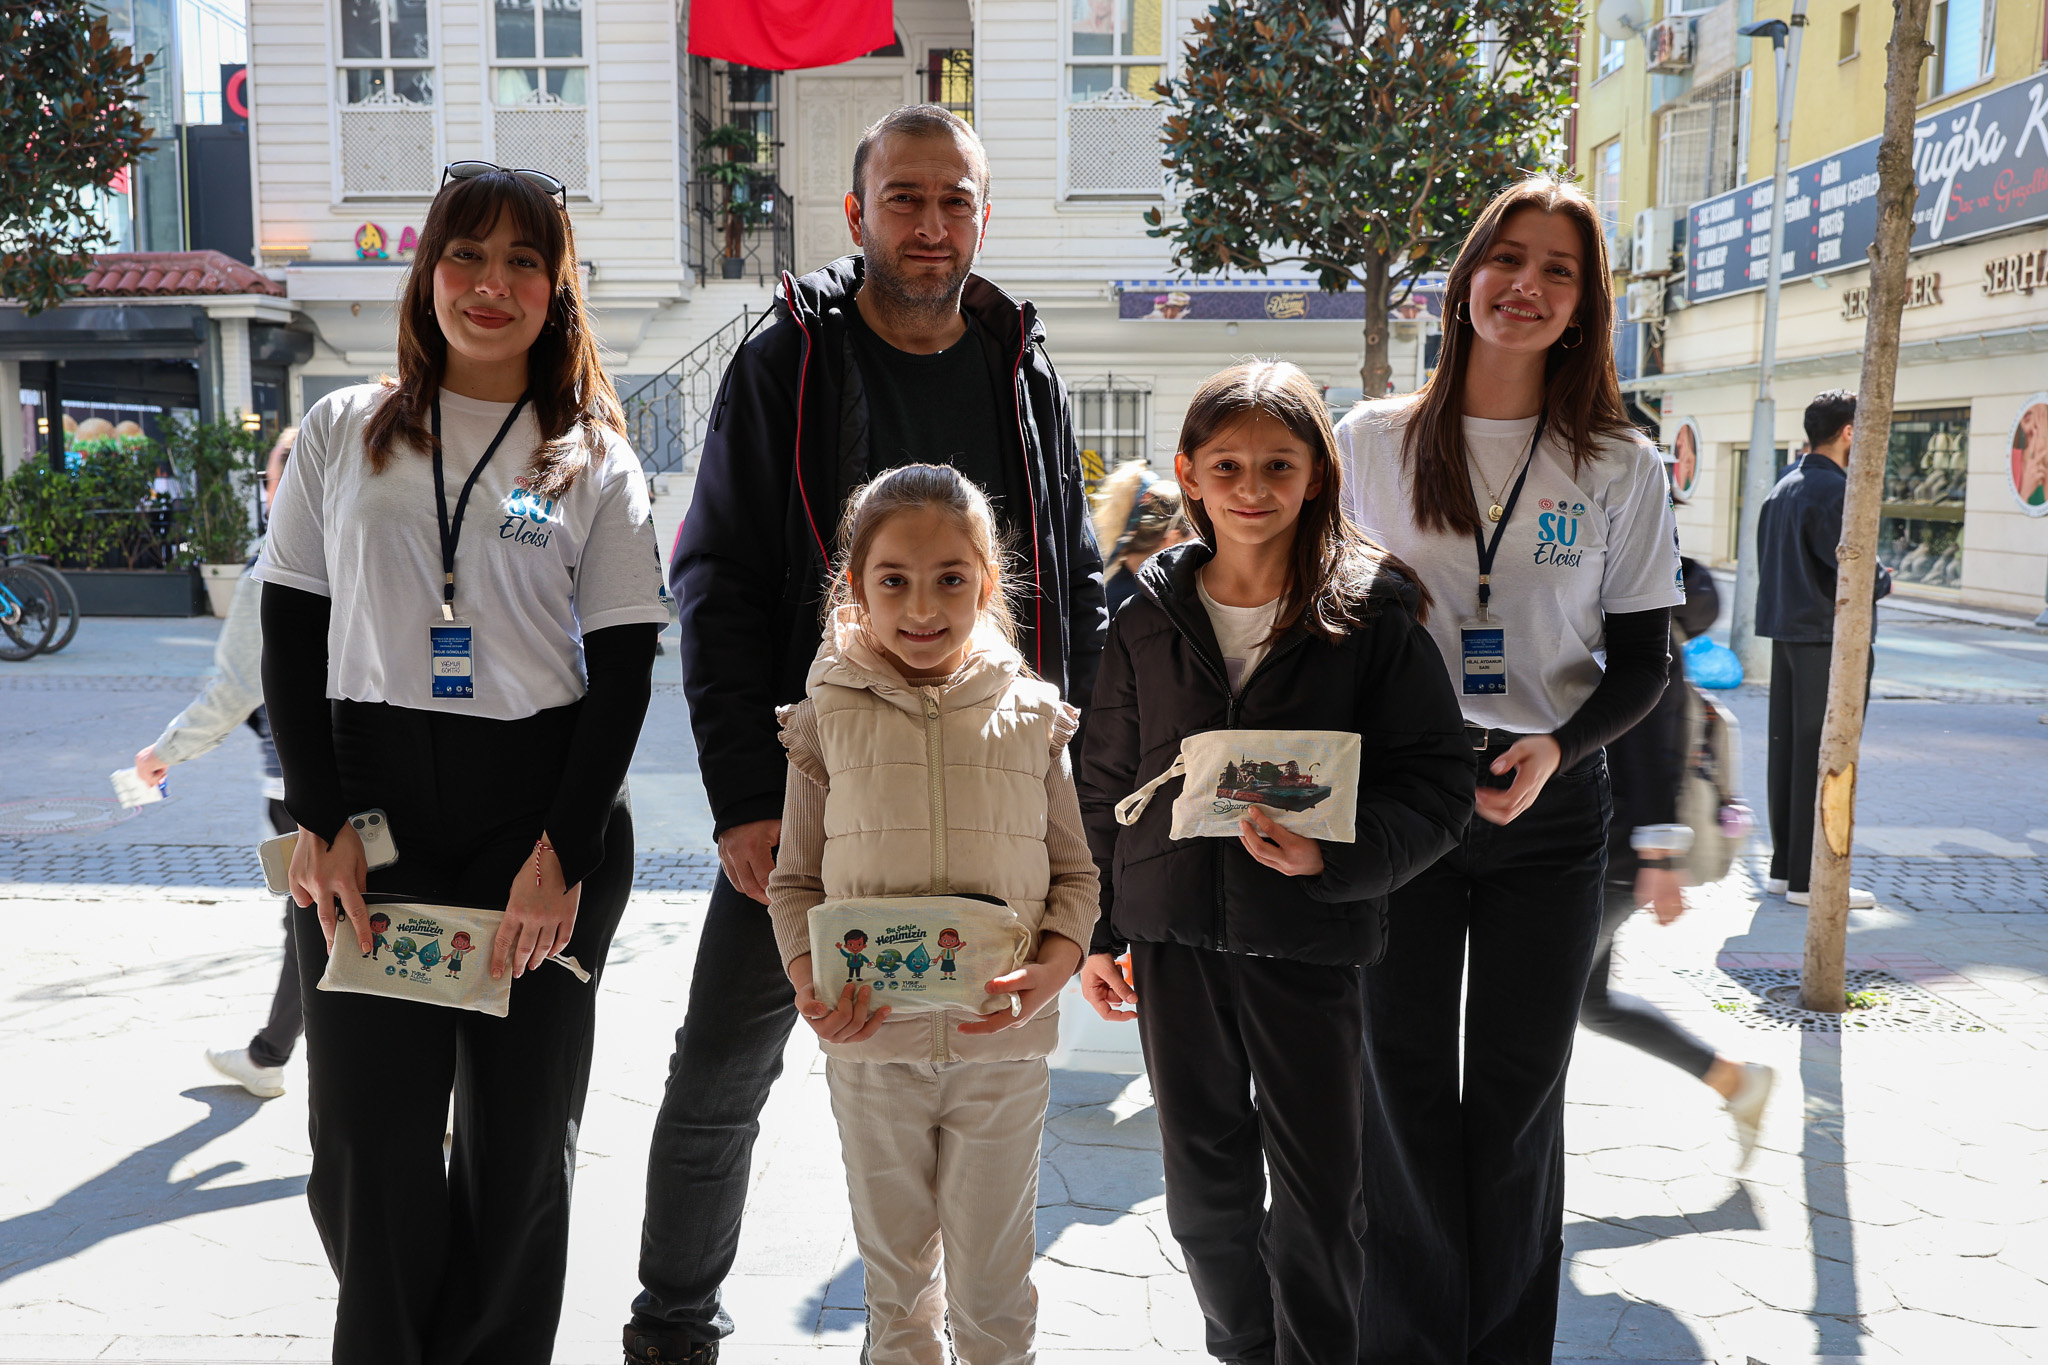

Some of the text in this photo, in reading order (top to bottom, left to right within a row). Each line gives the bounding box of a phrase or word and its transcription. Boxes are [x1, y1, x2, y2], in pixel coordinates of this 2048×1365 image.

[1912, 102, 2007, 240] Tuğba
[500, 516, 552, 548] Elçisi
[1538, 512, 1577, 546] SU
[1533, 542, 1582, 568] Elçisi
[396, 923, 444, 935] Hepimizin
[876, 929, 927, 946] Hepimizin
[897, 924, 917, 934] Şehir
